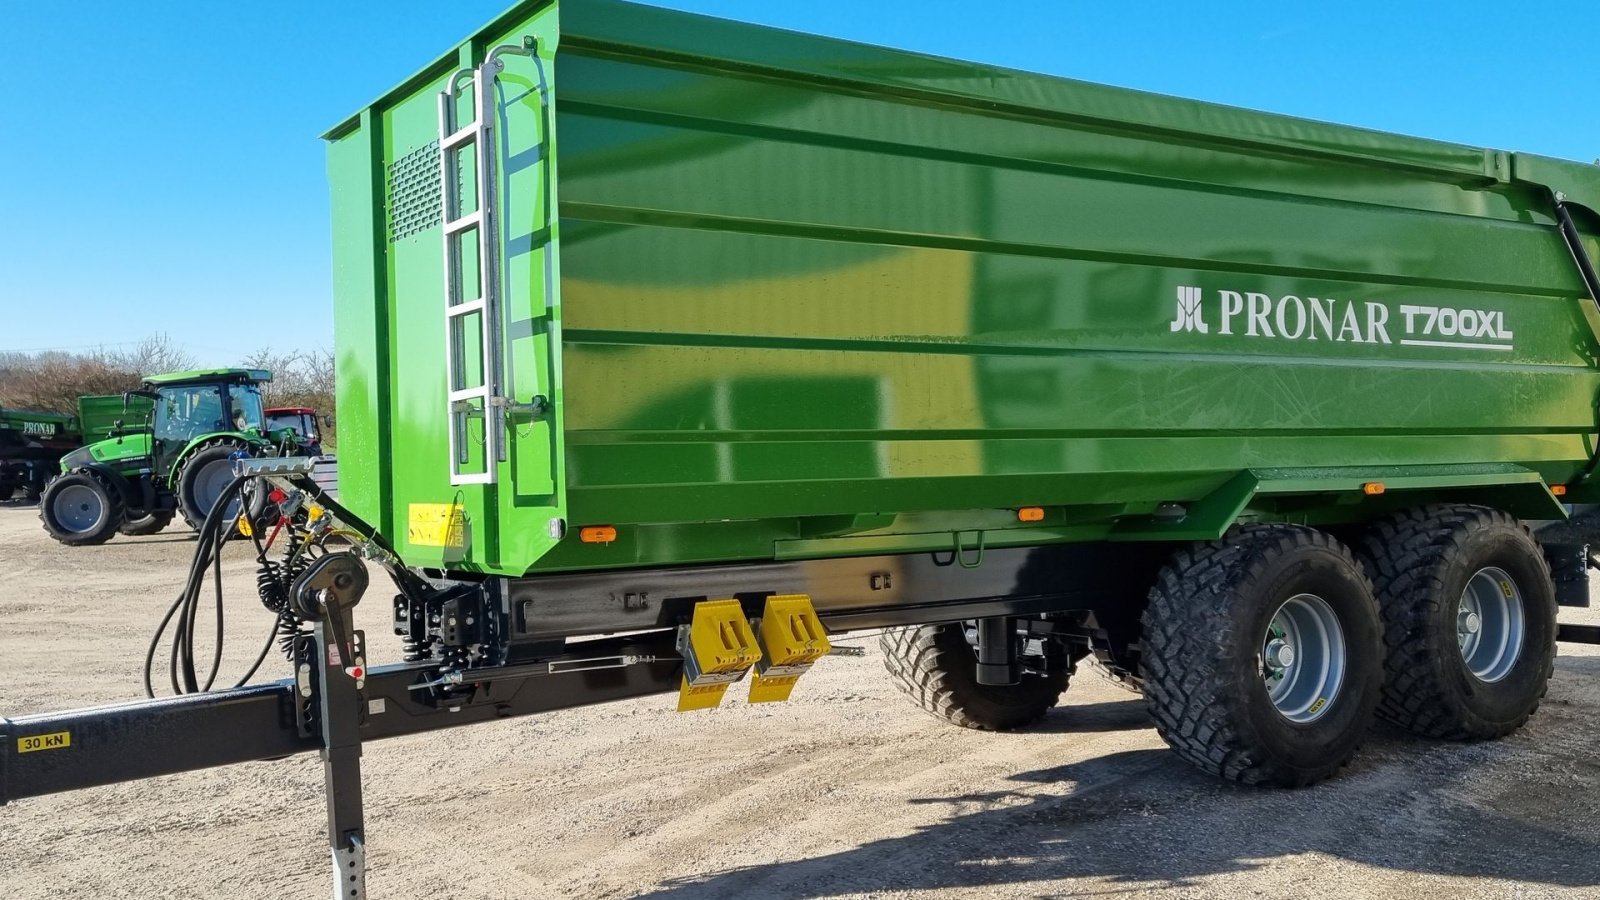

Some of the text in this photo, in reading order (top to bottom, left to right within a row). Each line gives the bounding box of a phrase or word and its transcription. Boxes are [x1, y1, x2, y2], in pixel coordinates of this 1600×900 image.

[1217, 289, 1513, 344] PRONAR T700XL
[23, 421, 56, 435] PRONAR
[24, 734, 64, 750] 30 kN
